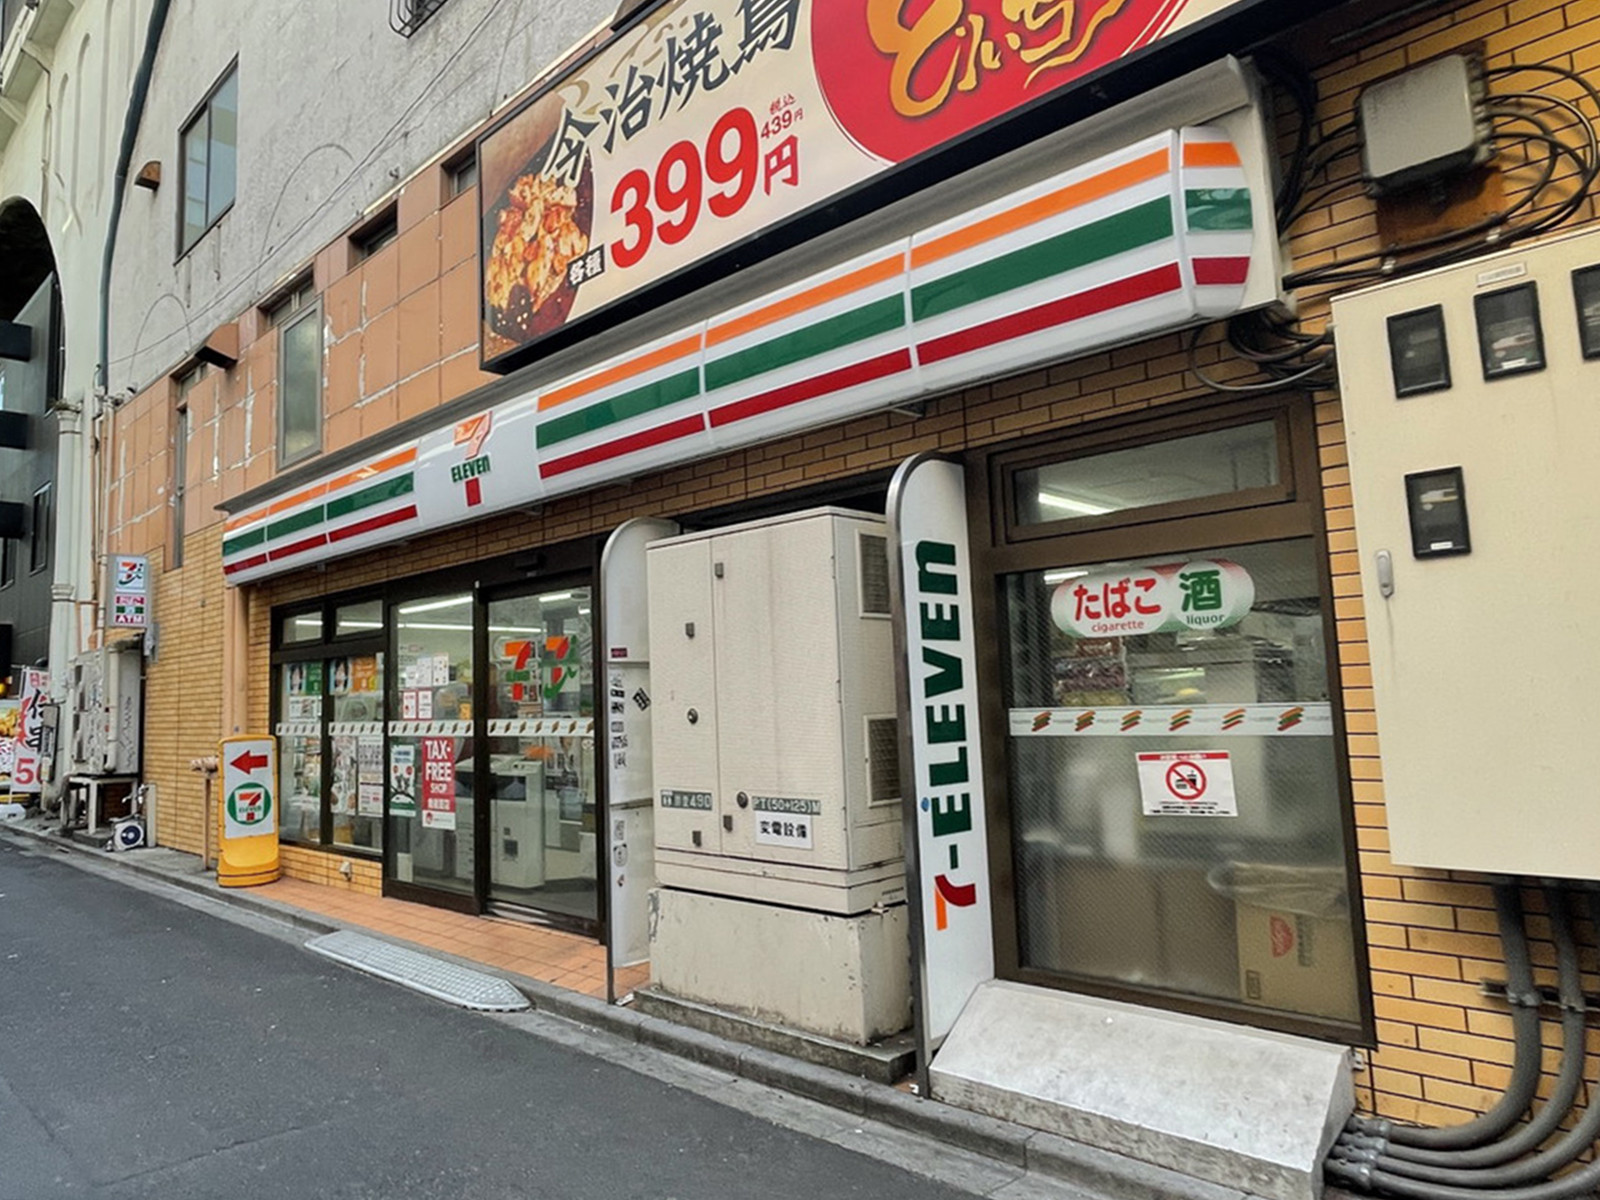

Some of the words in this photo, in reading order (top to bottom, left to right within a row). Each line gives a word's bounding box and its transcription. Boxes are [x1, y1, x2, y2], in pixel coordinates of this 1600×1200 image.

[543, 0, 801, 182] 今治焼鳥
[1073, 577, 1162, 622] たばこ
[1178, 569, 1223, 612] 酒
[1091, 619, 1145, 634] cigarette
[1185, 614, 1226, 626] liquor
[424, 761, 452, 782] FREE
